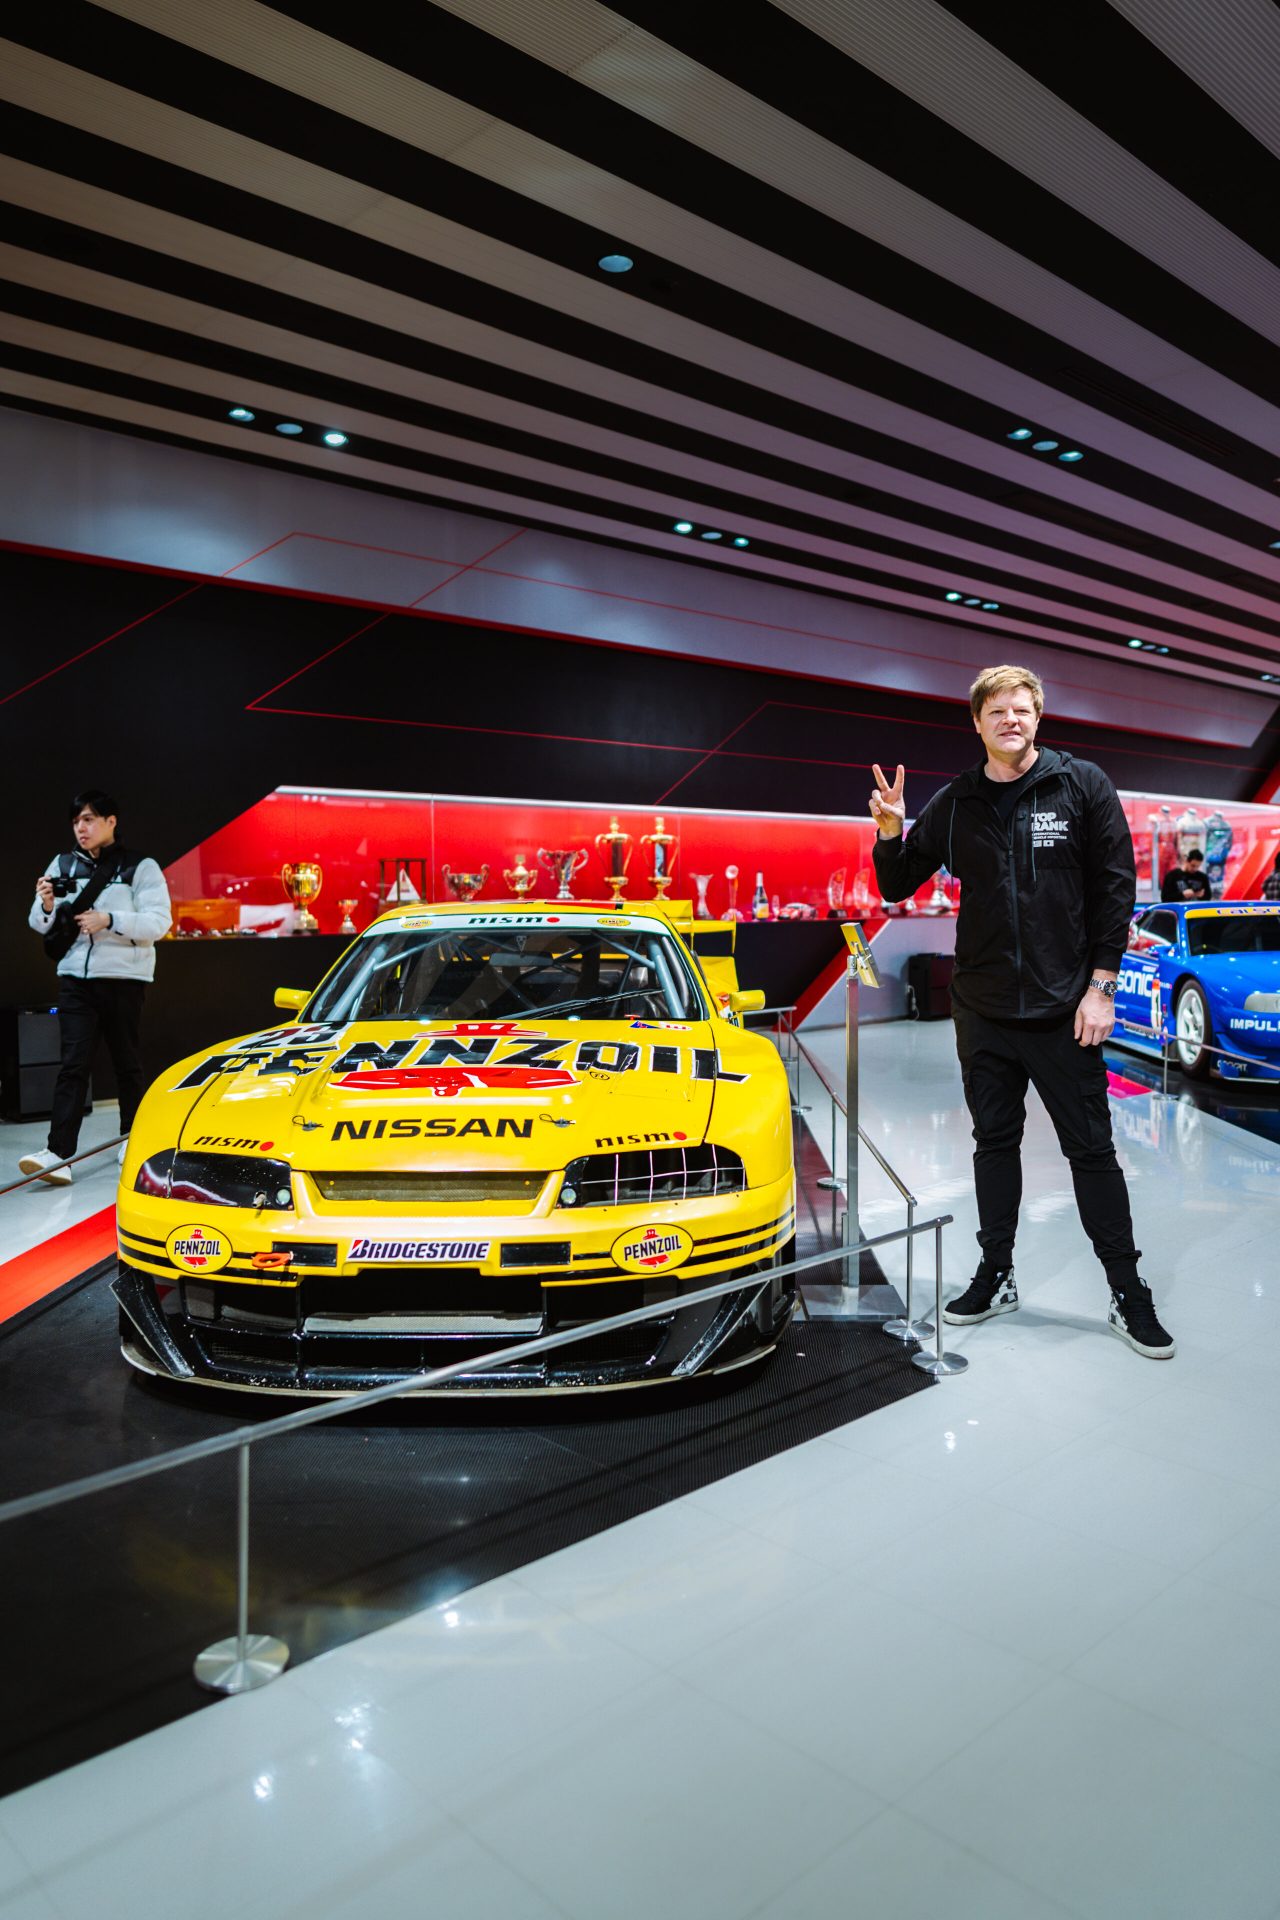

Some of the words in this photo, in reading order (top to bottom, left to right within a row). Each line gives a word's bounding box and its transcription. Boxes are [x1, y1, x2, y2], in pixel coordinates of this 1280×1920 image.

[1031, 812, 1057, 822] TOP
[1031, 821, 1069, 831] RANK
[1230, 1018, 1280, 1032] IMPUL
[168, 1036, 751, 1093] PENNZOIL
[331, 1118, 534, 1141] NISSAN
[174, 1240, 221, 1256] PENNZOIL
[348, 1239, 489, 1259] BRIDGESTONE
[624, 1234, 682, 1261] PENNZOIL
